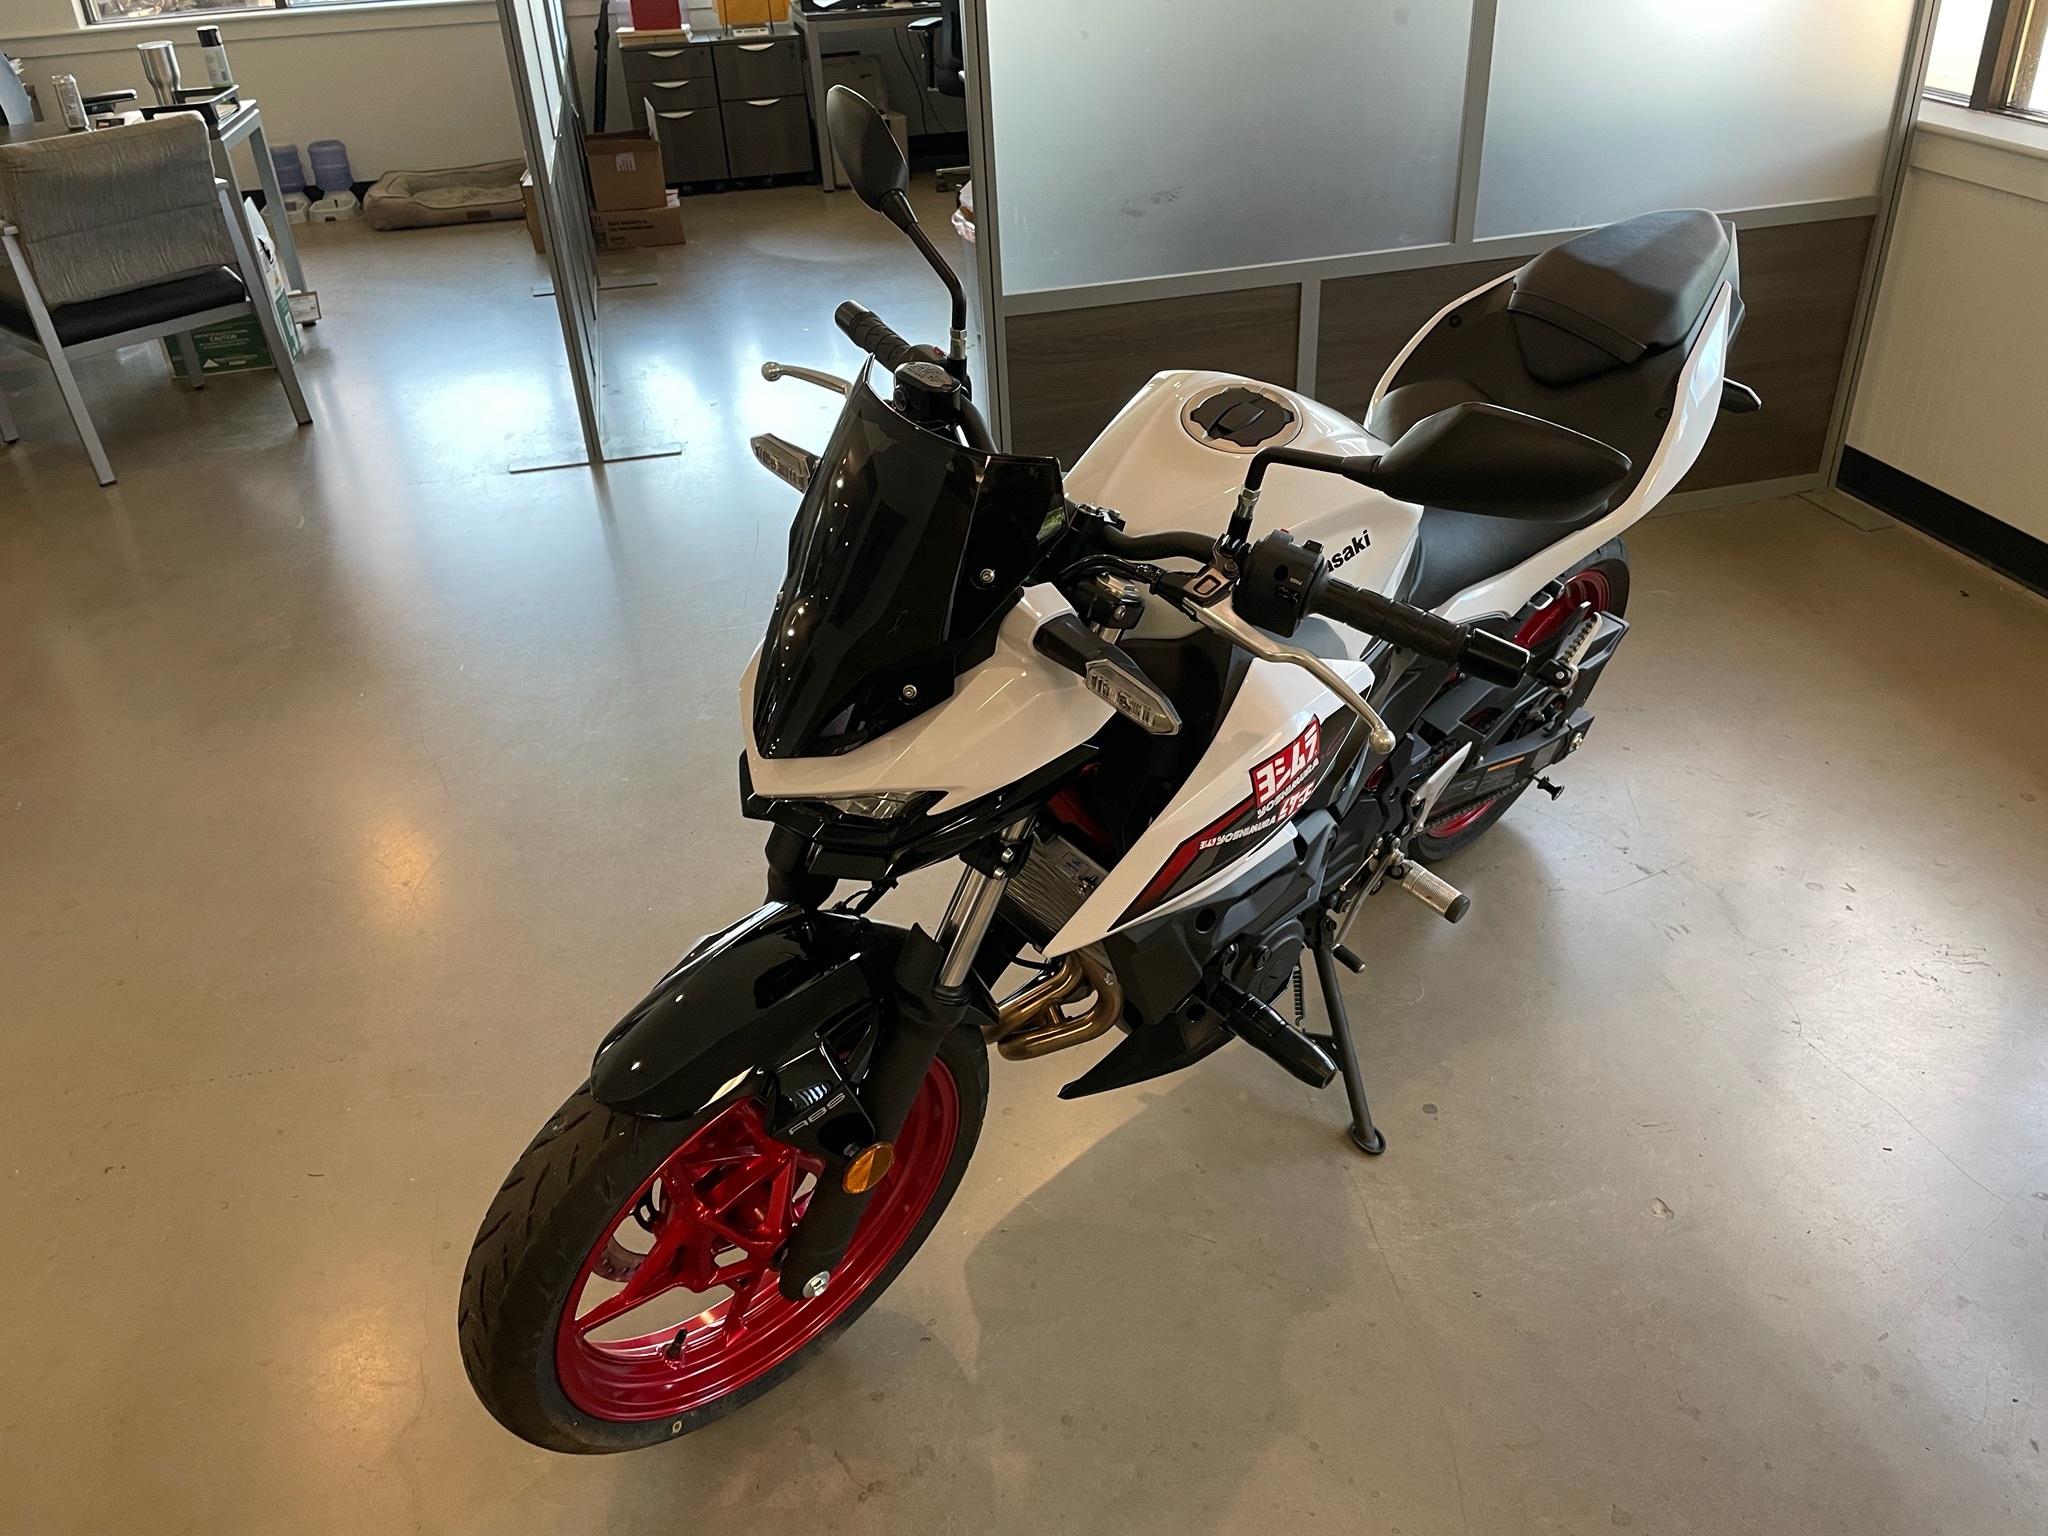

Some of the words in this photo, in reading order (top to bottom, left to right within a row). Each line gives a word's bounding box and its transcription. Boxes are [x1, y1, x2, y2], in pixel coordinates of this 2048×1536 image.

[1256, 723, 1318, 804] ヨシムラ
[1257, 758, 1320, 819] YOSHIMURA
[1216, 815, 1276, 846] YOSHIMURA
[788, 1092, 846, 1136] ABS
